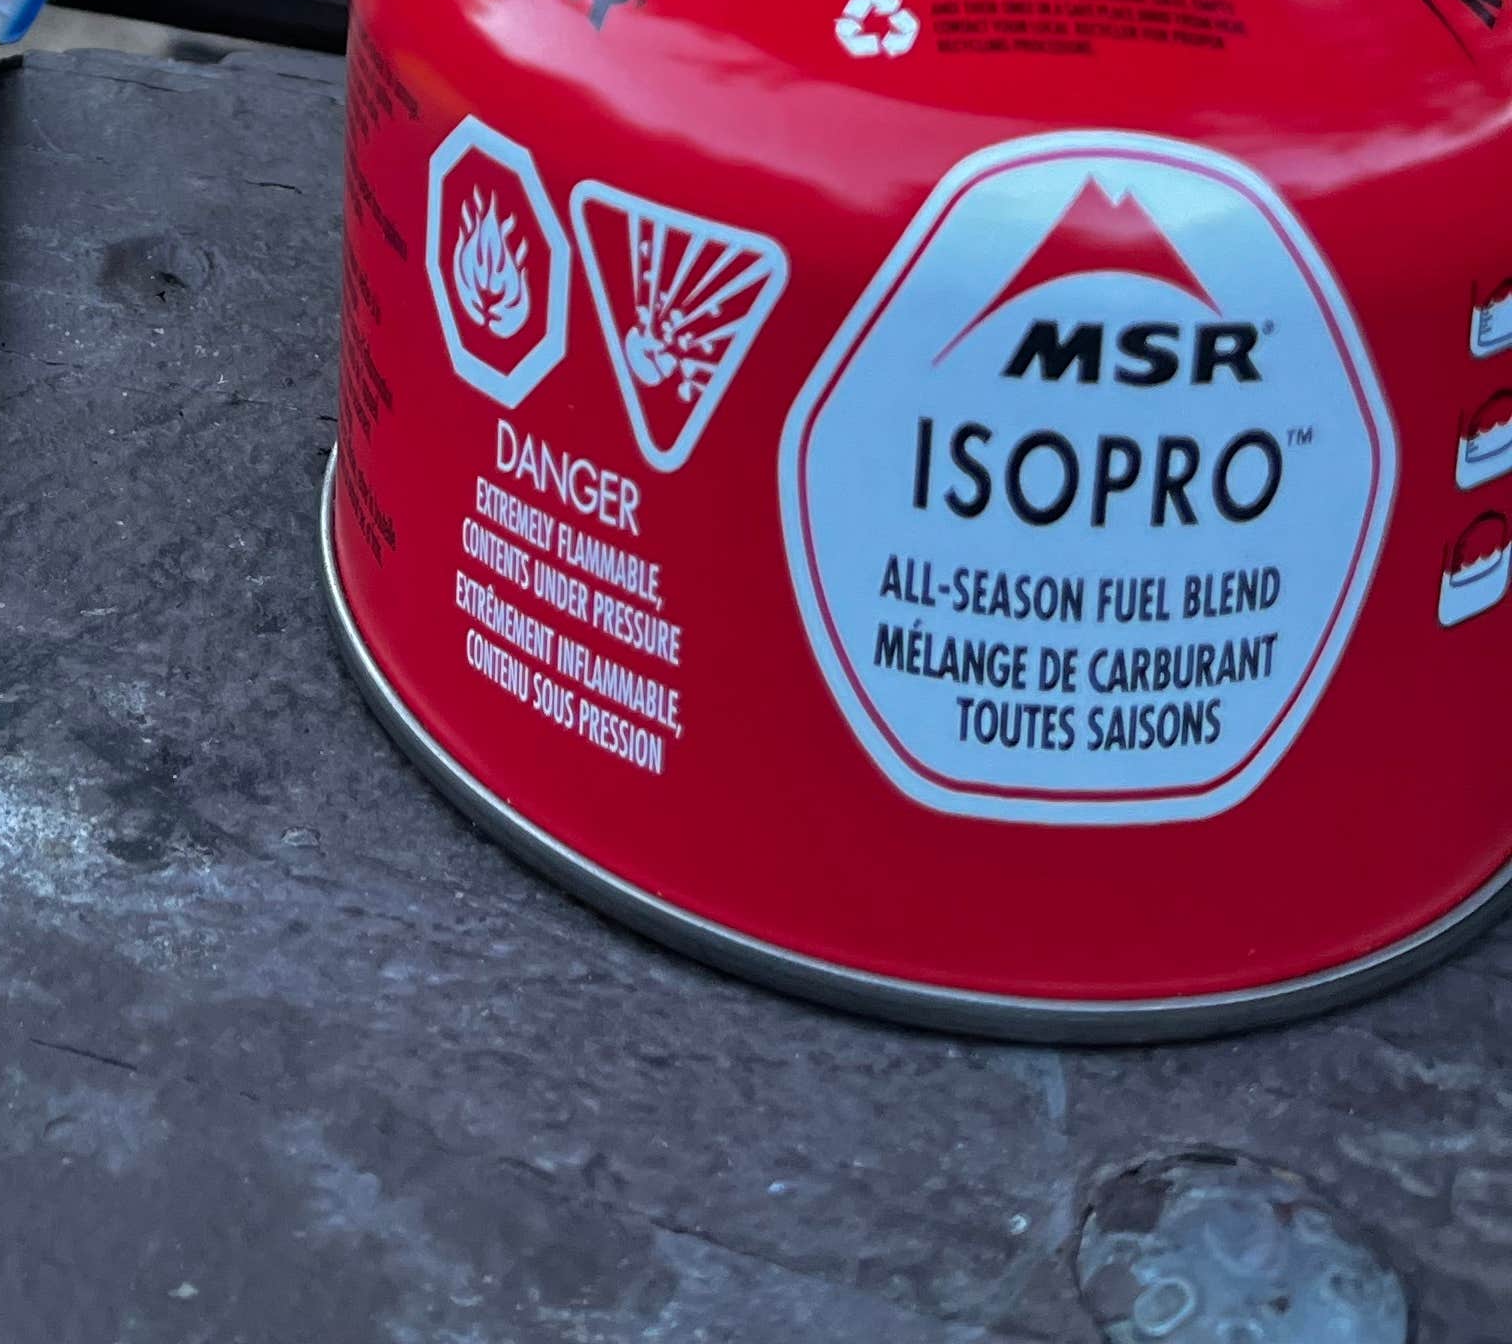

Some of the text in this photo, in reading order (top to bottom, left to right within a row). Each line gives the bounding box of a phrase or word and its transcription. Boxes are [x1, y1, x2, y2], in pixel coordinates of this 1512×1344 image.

[497, 418, 641, 536] DANGER
[462, 518, 682, 666] CONTENTS UNDER PRESSURE
[476, 475, 554, 552] EXTREMELY
[558, 522, 665, 612] FLAMMABLE,
[879, 553, 1282, 624] ALL-SEASON FUEL BLEND
[456, 570, 684, 740] EXTRÊMEMENT INFLAMMABLE,
[466, 628, 664, 776] CONTENU SOUS PRESSION
[872, 618, 1278, 694] MÉLANGE DE CARBURANT
[956, 696, 1223, 752] TOUTES SAISONS
